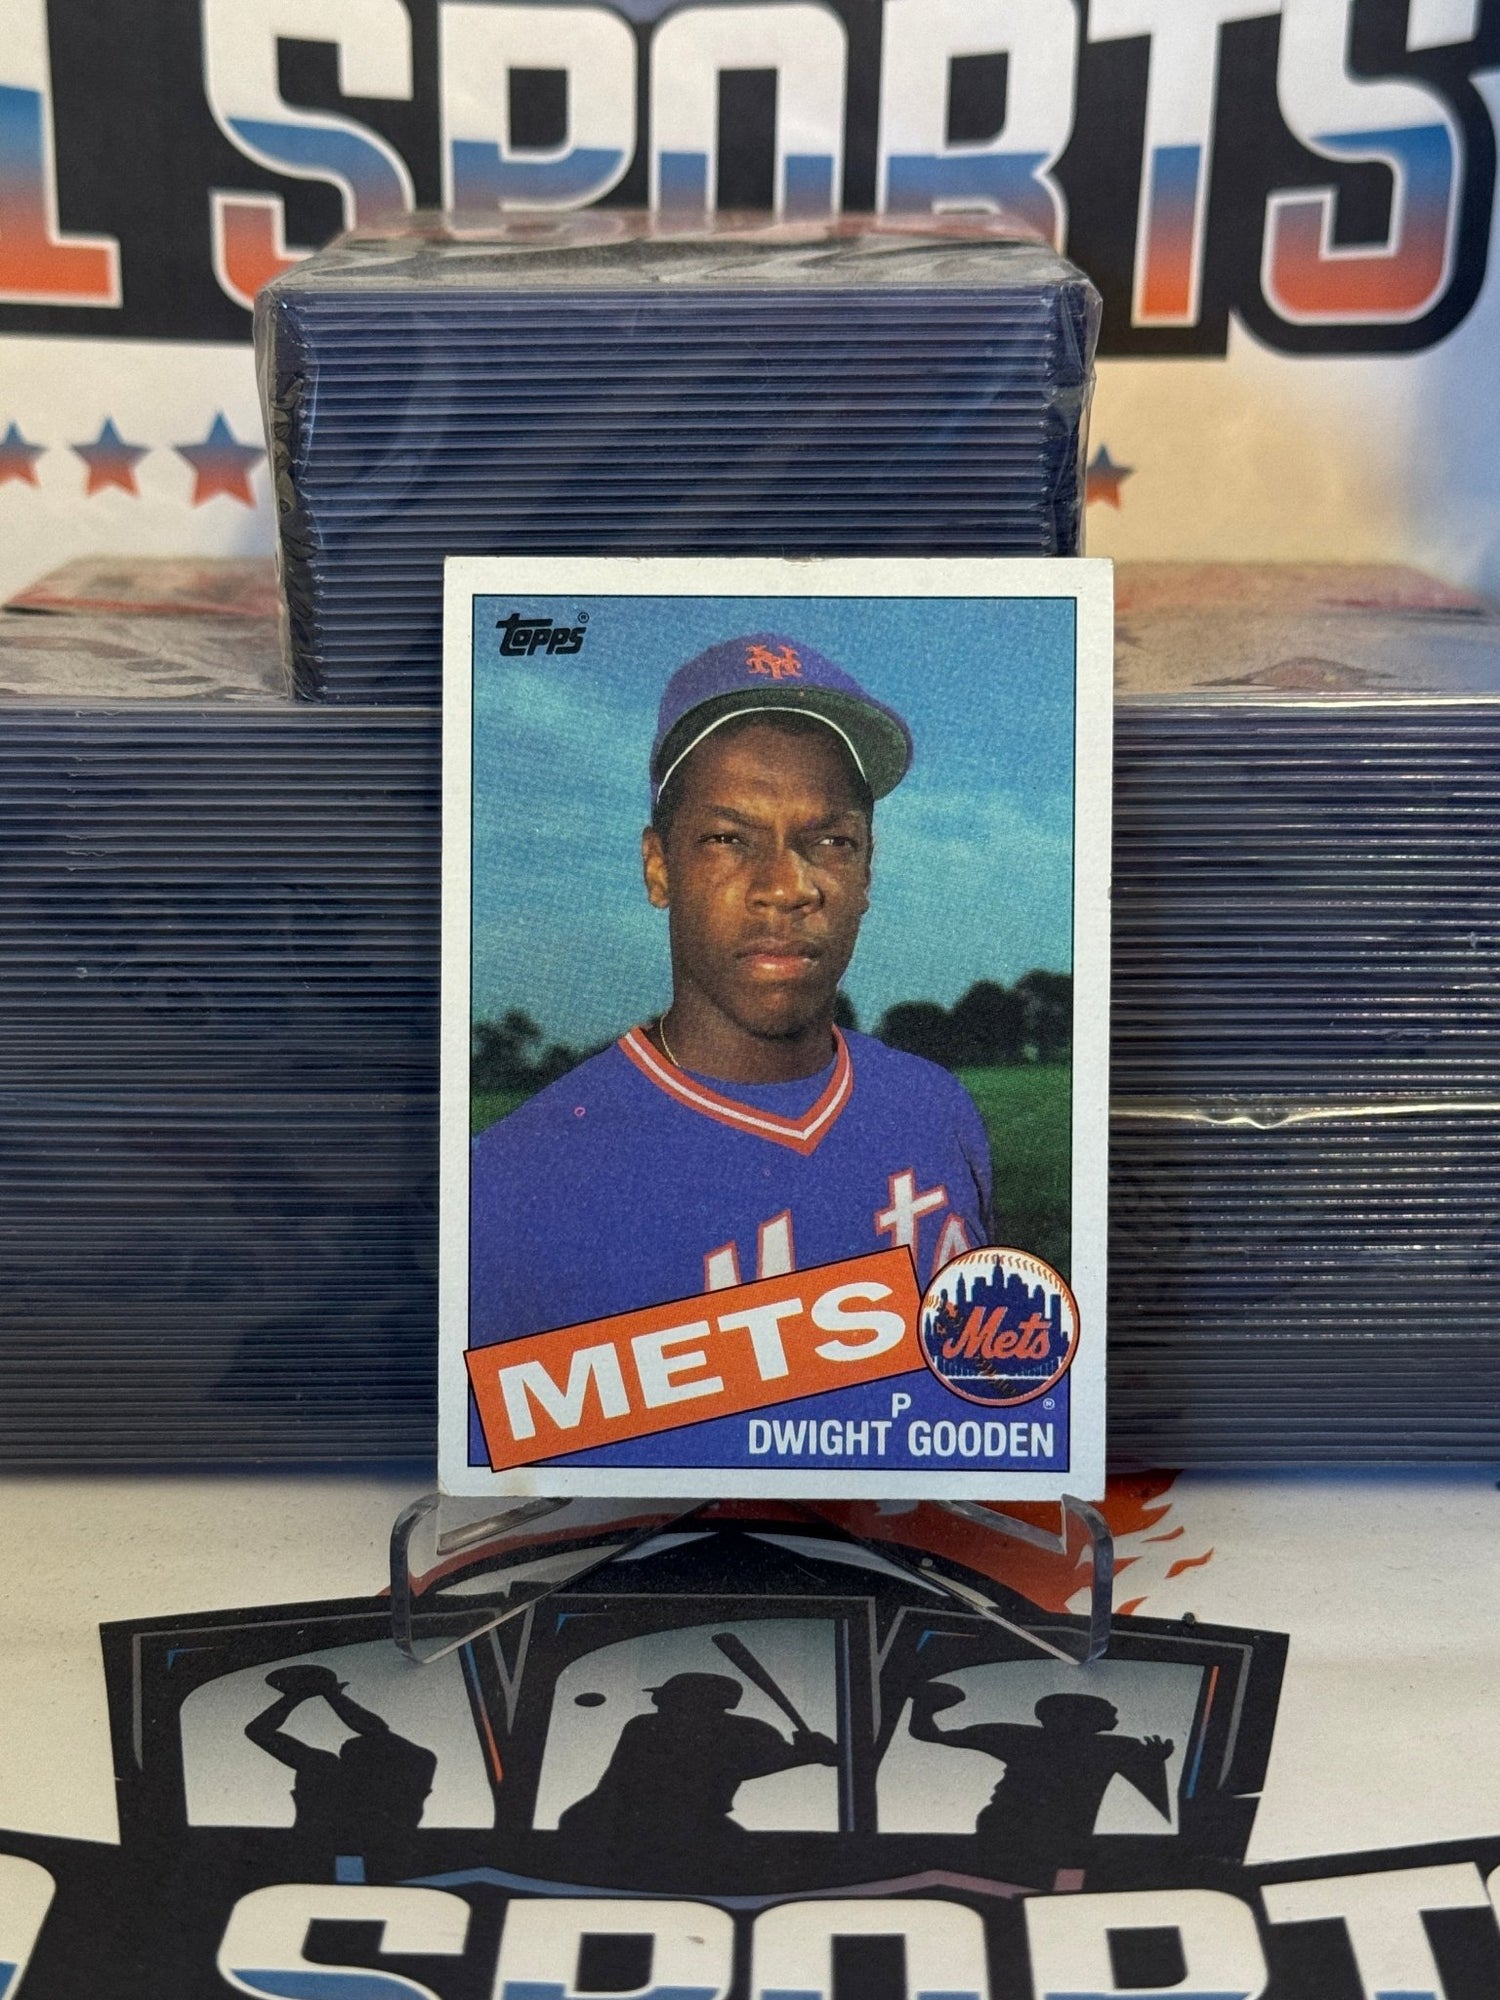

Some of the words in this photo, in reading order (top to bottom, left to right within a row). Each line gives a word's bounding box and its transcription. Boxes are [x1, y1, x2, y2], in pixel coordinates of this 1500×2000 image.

[203, 0, 1464, 326] SPORTS
[942, 1306, 1052, 1360] Mets
[498, 1281, 906, 1441] METS
[891, 1393, 911, 1418] P
[748, 1418, 891, 1457] DWIGHT
[908, 1420, 1054, 1458] GOODEN
